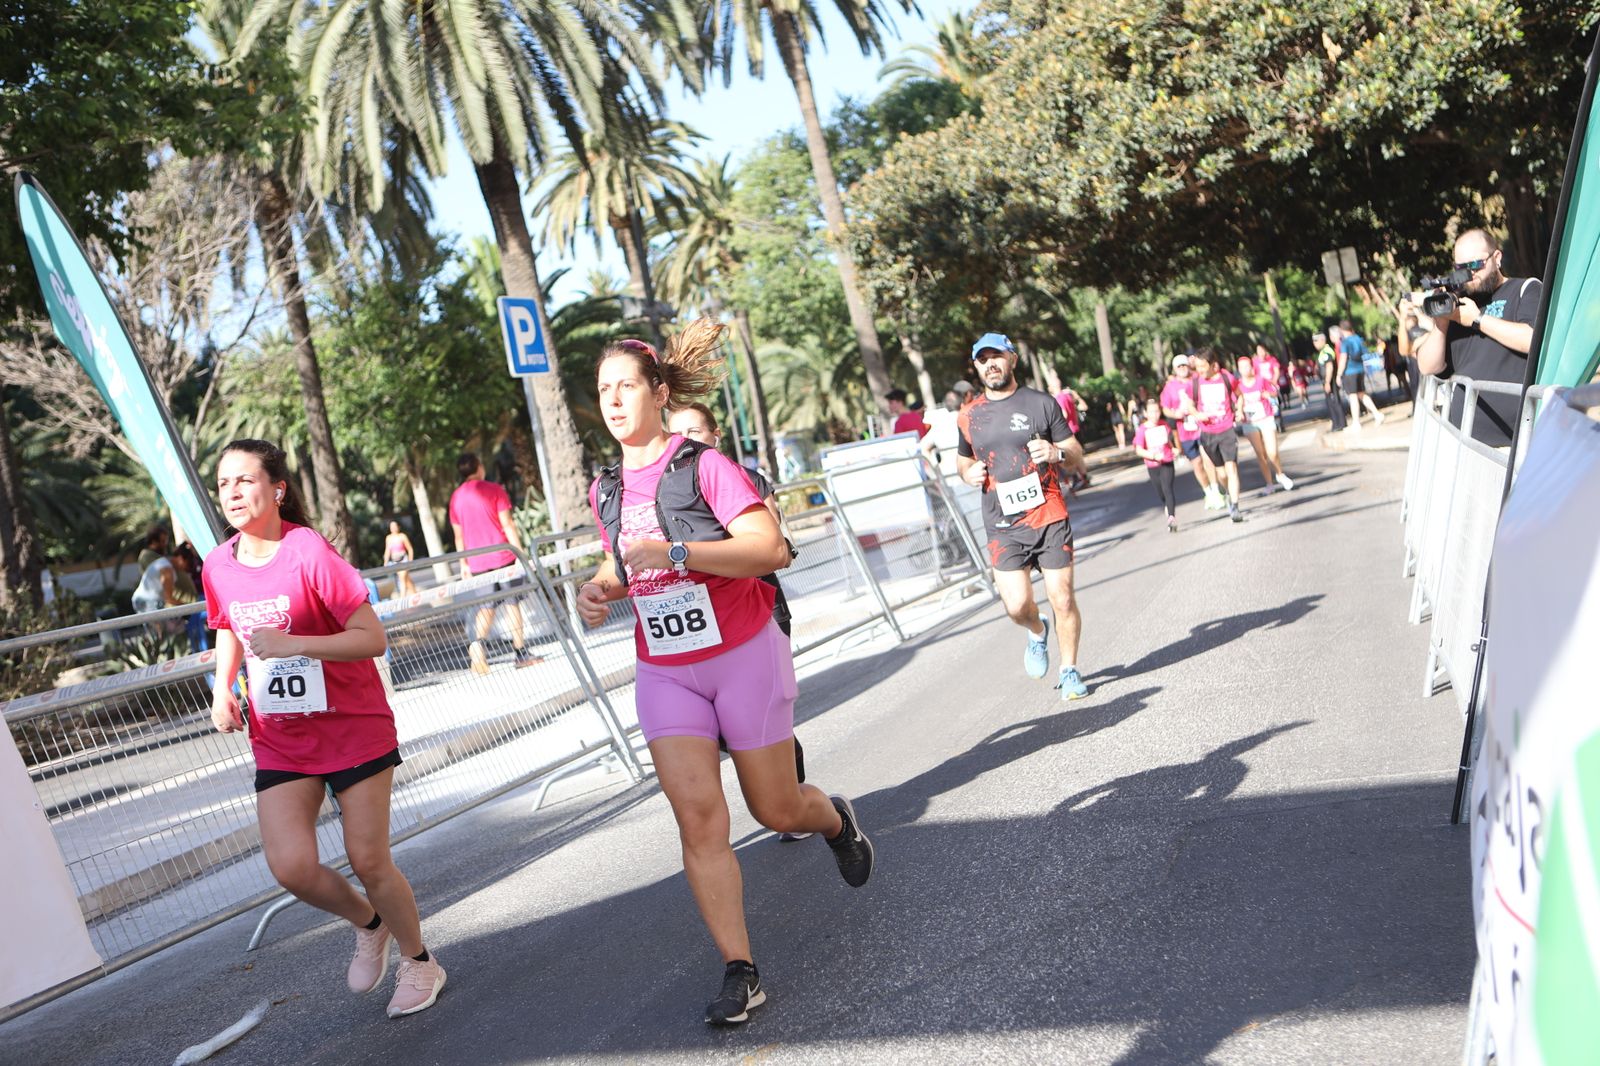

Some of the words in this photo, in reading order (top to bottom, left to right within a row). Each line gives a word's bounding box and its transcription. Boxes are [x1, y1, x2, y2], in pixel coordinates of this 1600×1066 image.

[509, 306, 536, 366] P
[1005, 485, 1038, 504] 165
[647, 608, 707, 639] 508
[268, 675, 306, 698] 40
